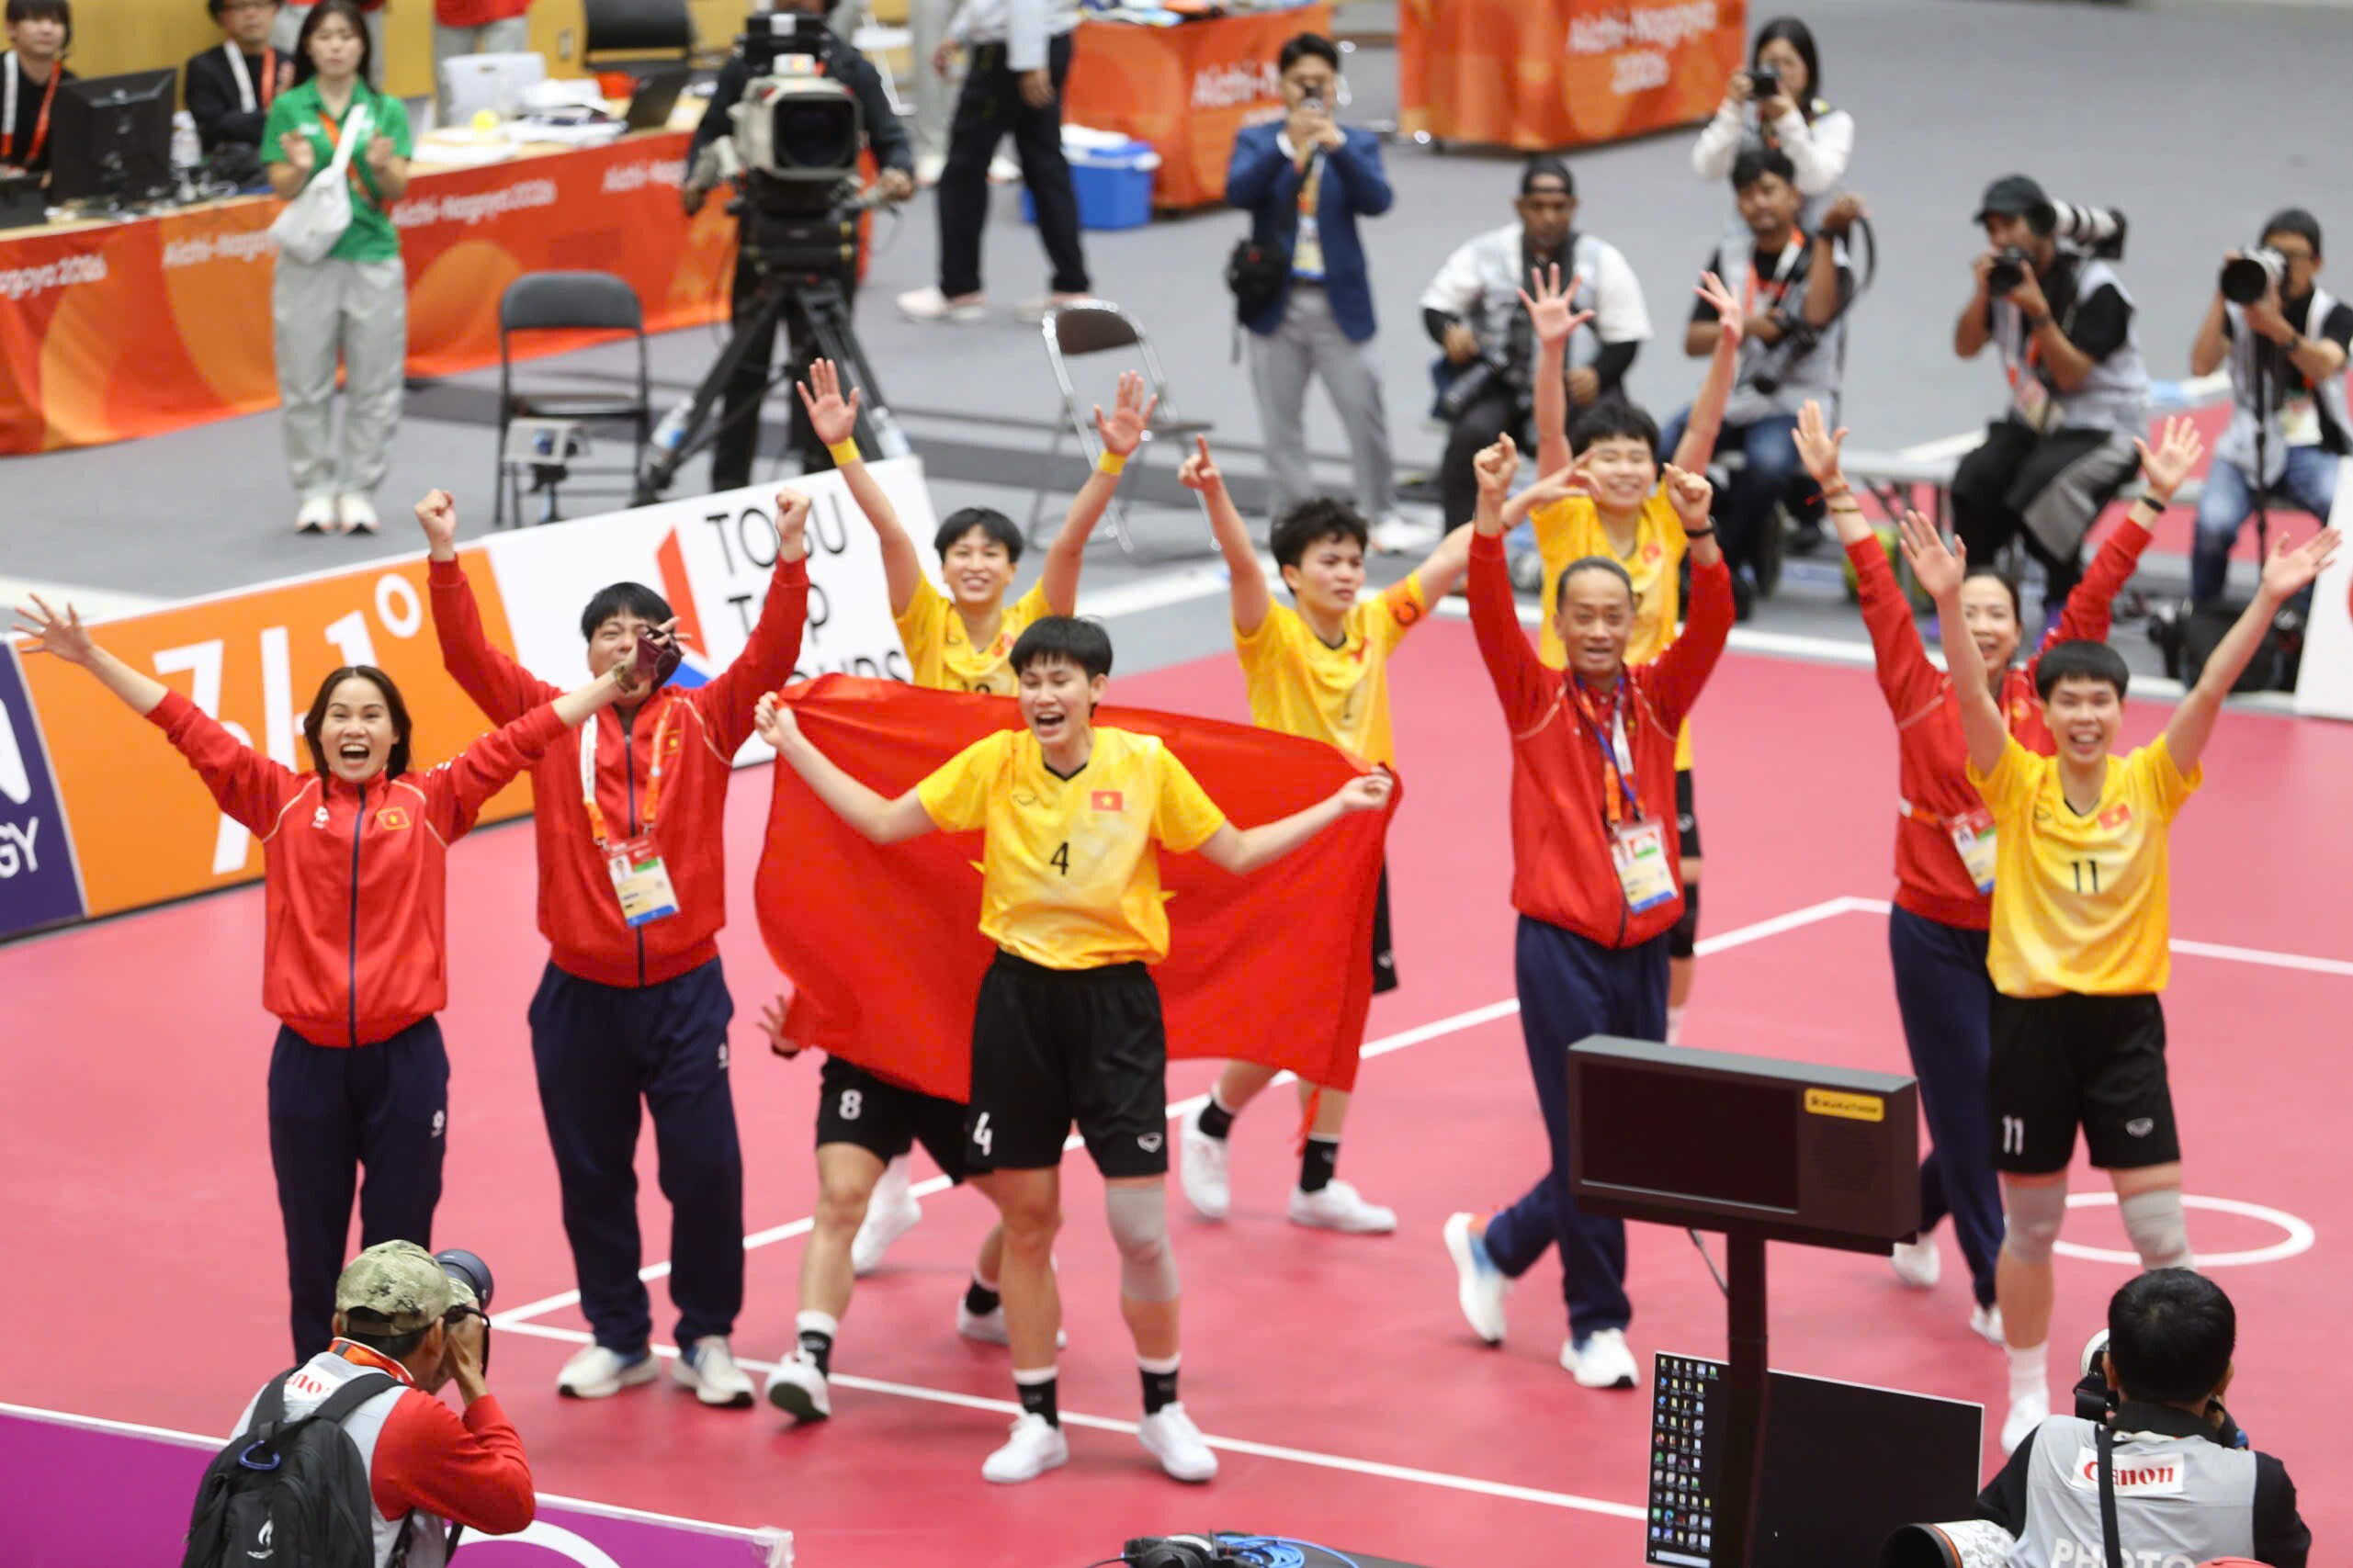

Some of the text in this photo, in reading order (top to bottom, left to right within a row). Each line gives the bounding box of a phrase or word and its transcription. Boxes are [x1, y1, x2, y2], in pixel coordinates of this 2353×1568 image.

[727, 581, 831, 645] TP
[1050, 840, 1069, 876] 4
[2070, 859, 2098, 893] 11
[839, 1089, 863, 1120] 8
[972, 1111, 993, 1156] 4
[2002, 1114, 2024, 1156] 11
[2051, 1537, 2196, 1568] PHT
